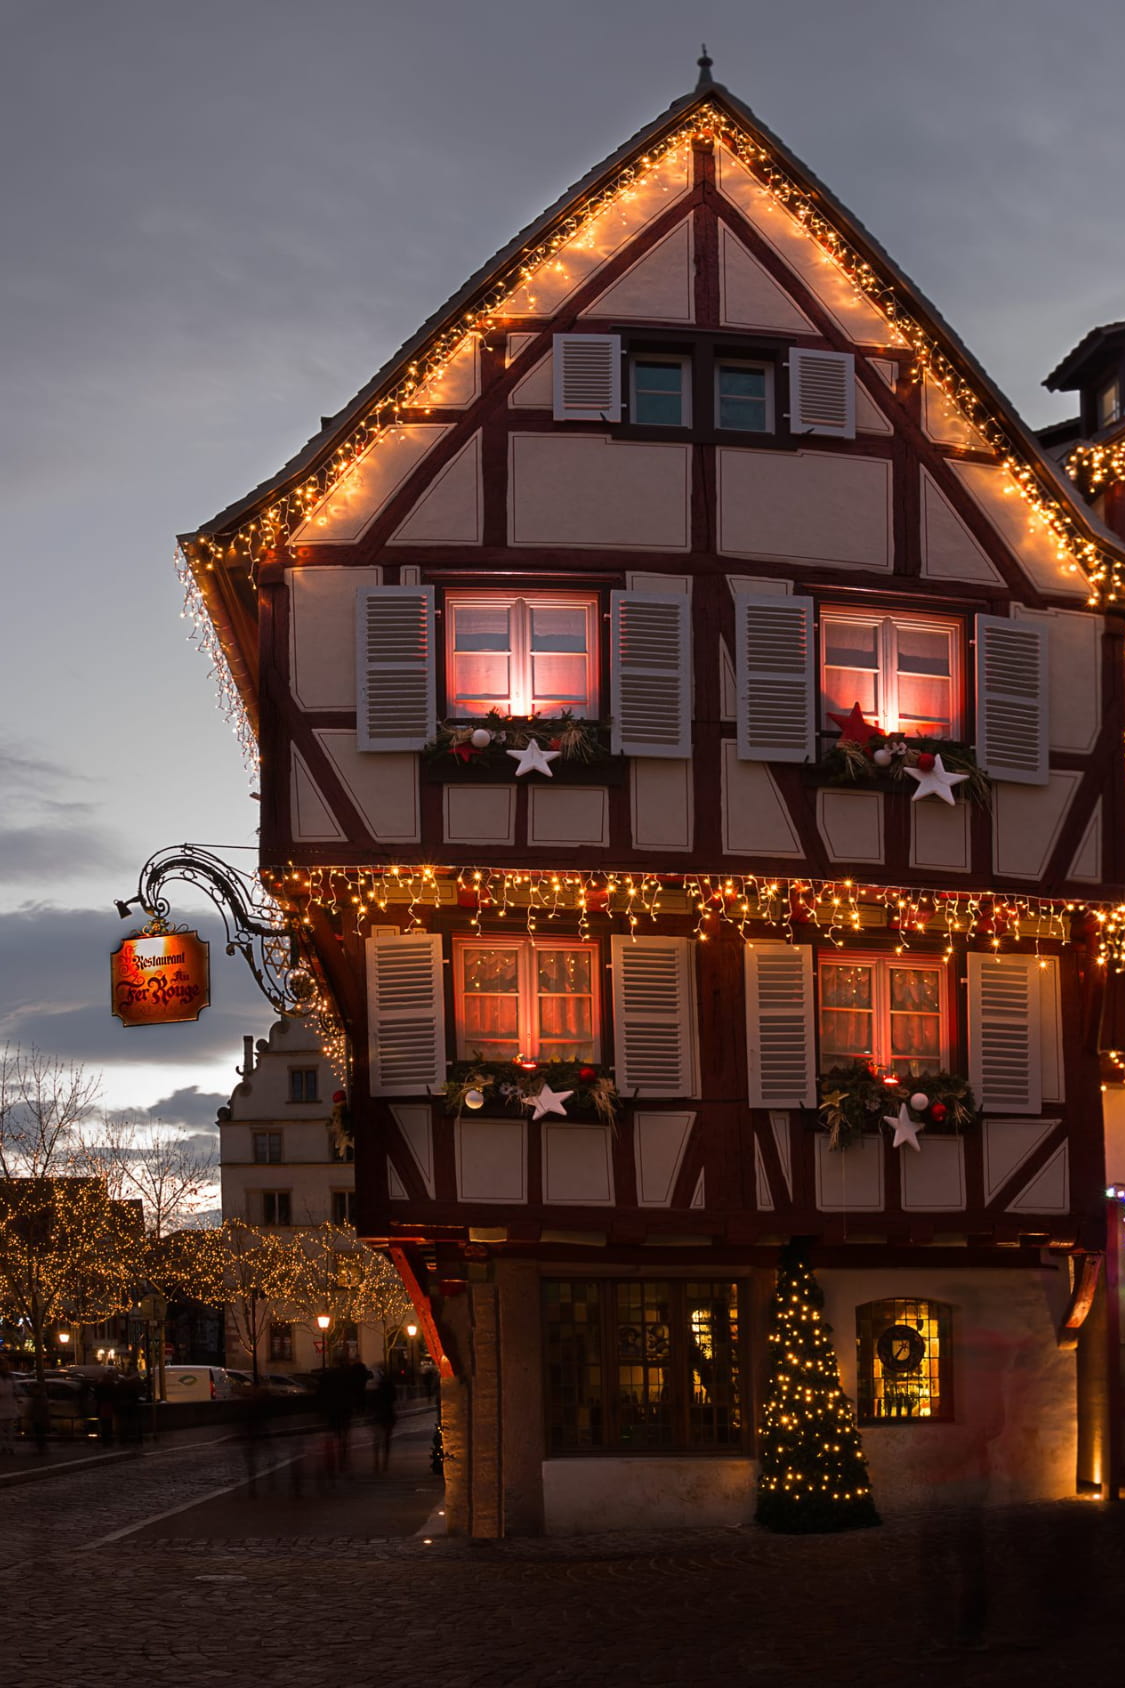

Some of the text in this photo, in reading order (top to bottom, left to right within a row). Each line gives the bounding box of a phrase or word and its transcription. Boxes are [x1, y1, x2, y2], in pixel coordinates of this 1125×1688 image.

[132, 952, 185, 970] Restaurant
[116, 974, 199, 1009] Fer Rouge
